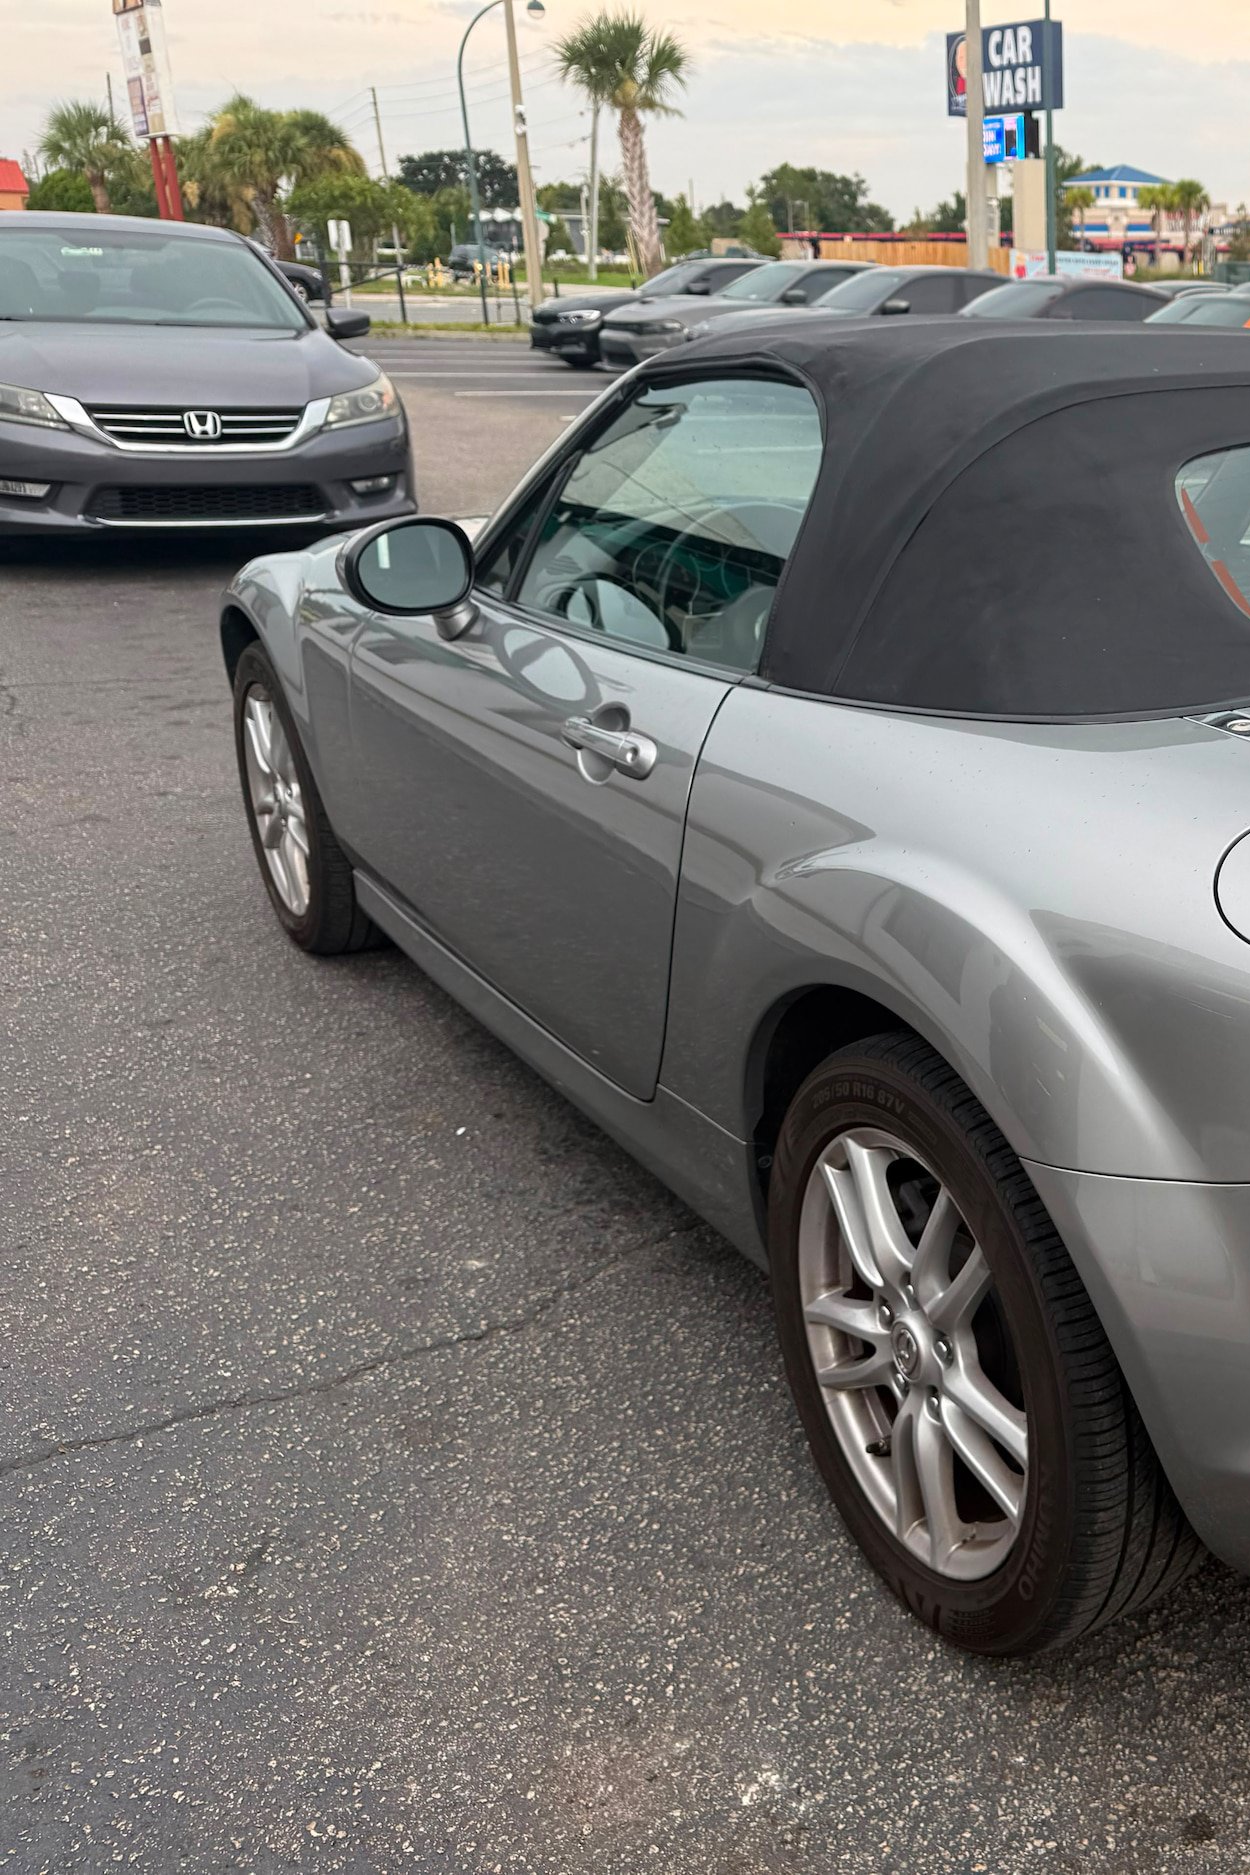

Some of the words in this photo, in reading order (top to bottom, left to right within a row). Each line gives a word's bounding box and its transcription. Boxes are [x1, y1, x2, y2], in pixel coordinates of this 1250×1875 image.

[988, 25, 1034, 68] CAR
[982, 65, 1042, 108] WASH
[811, 1082, 850, 1109] 205/50
[852, 1082, 875, 1099] R16
[877, 1089, 905, 1114] 87V
